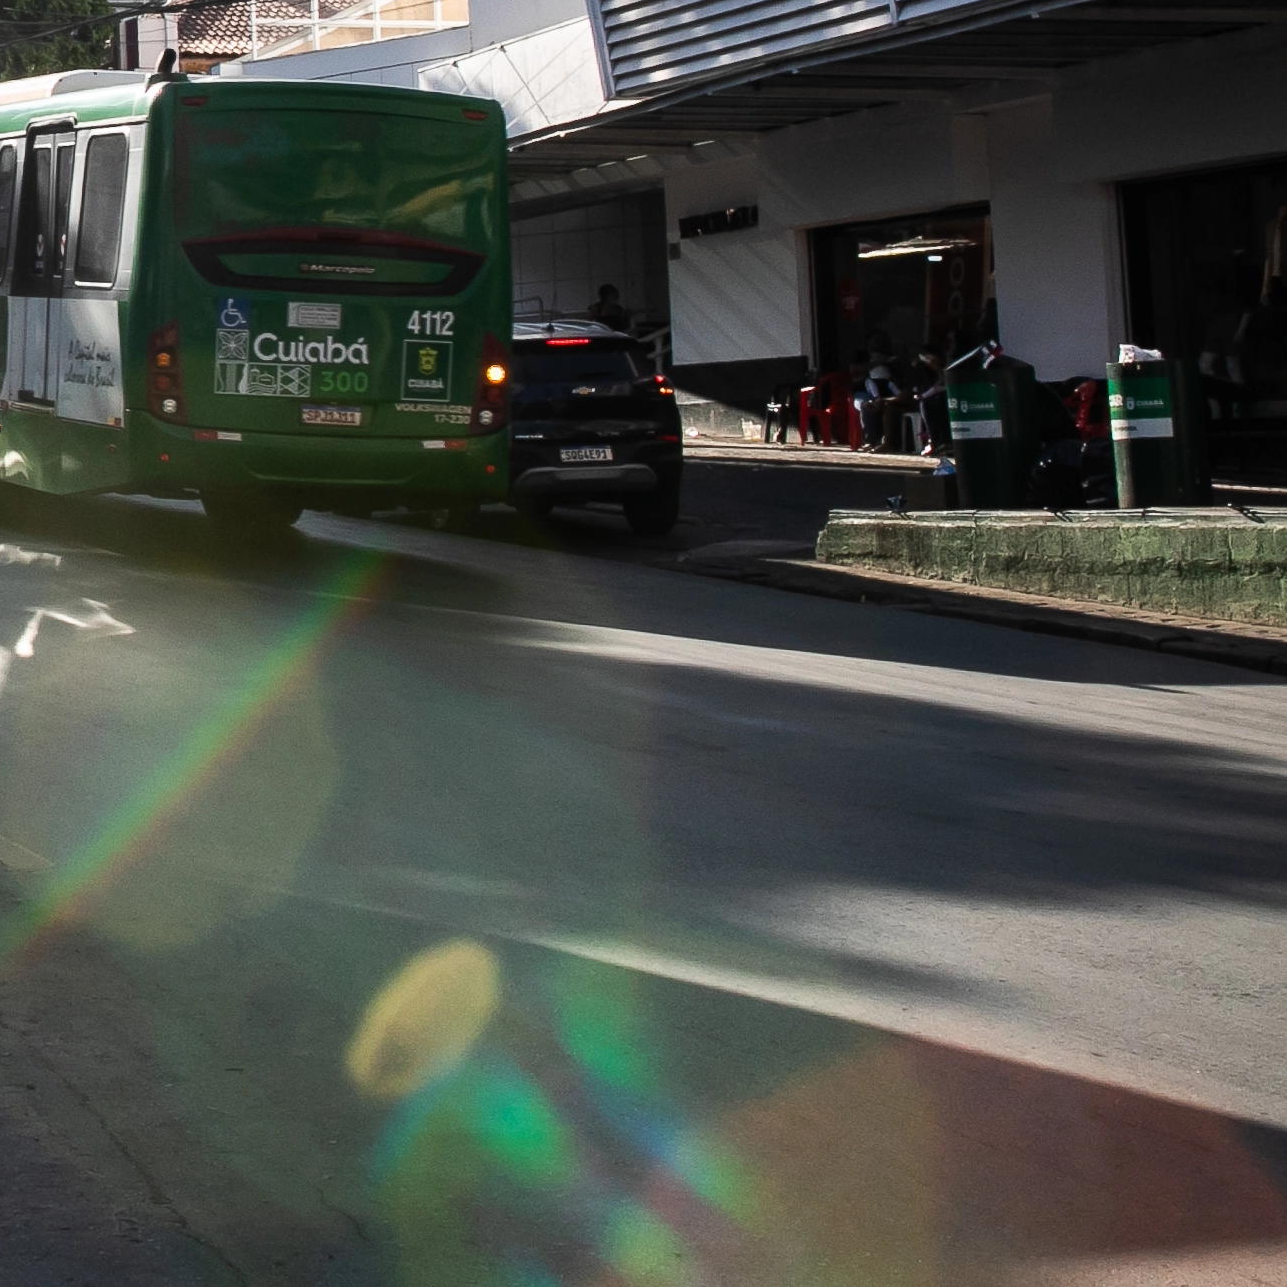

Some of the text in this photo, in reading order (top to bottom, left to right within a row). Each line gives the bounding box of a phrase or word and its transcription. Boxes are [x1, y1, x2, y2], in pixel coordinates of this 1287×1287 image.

[407, 310, 454, 335] 4112
[253, 332, 370, 365] Cuiabá
[320, 371, 370, 393] 300
[394, 403, 472, 414] VOLKSWAGEN
